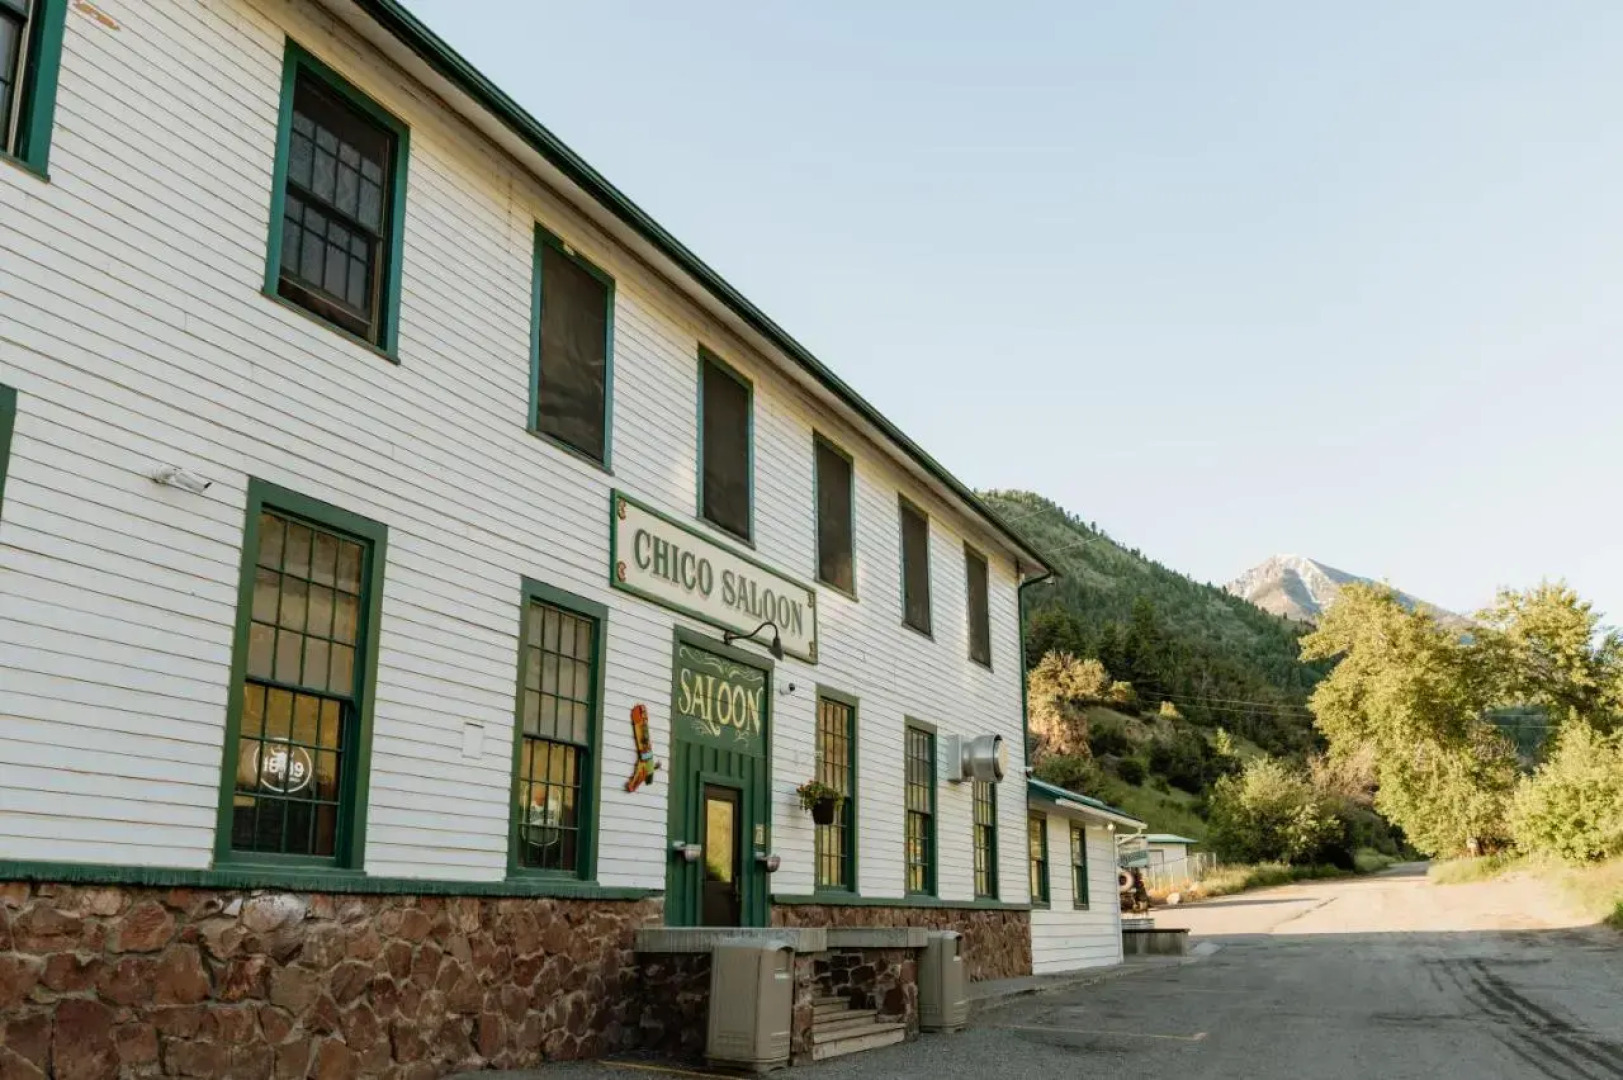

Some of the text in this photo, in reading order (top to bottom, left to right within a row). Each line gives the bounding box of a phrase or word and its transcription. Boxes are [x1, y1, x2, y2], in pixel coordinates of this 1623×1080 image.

[633, 528, 804, 637] CHICO SALOON
[678, 667, 764, 737] SALOON
